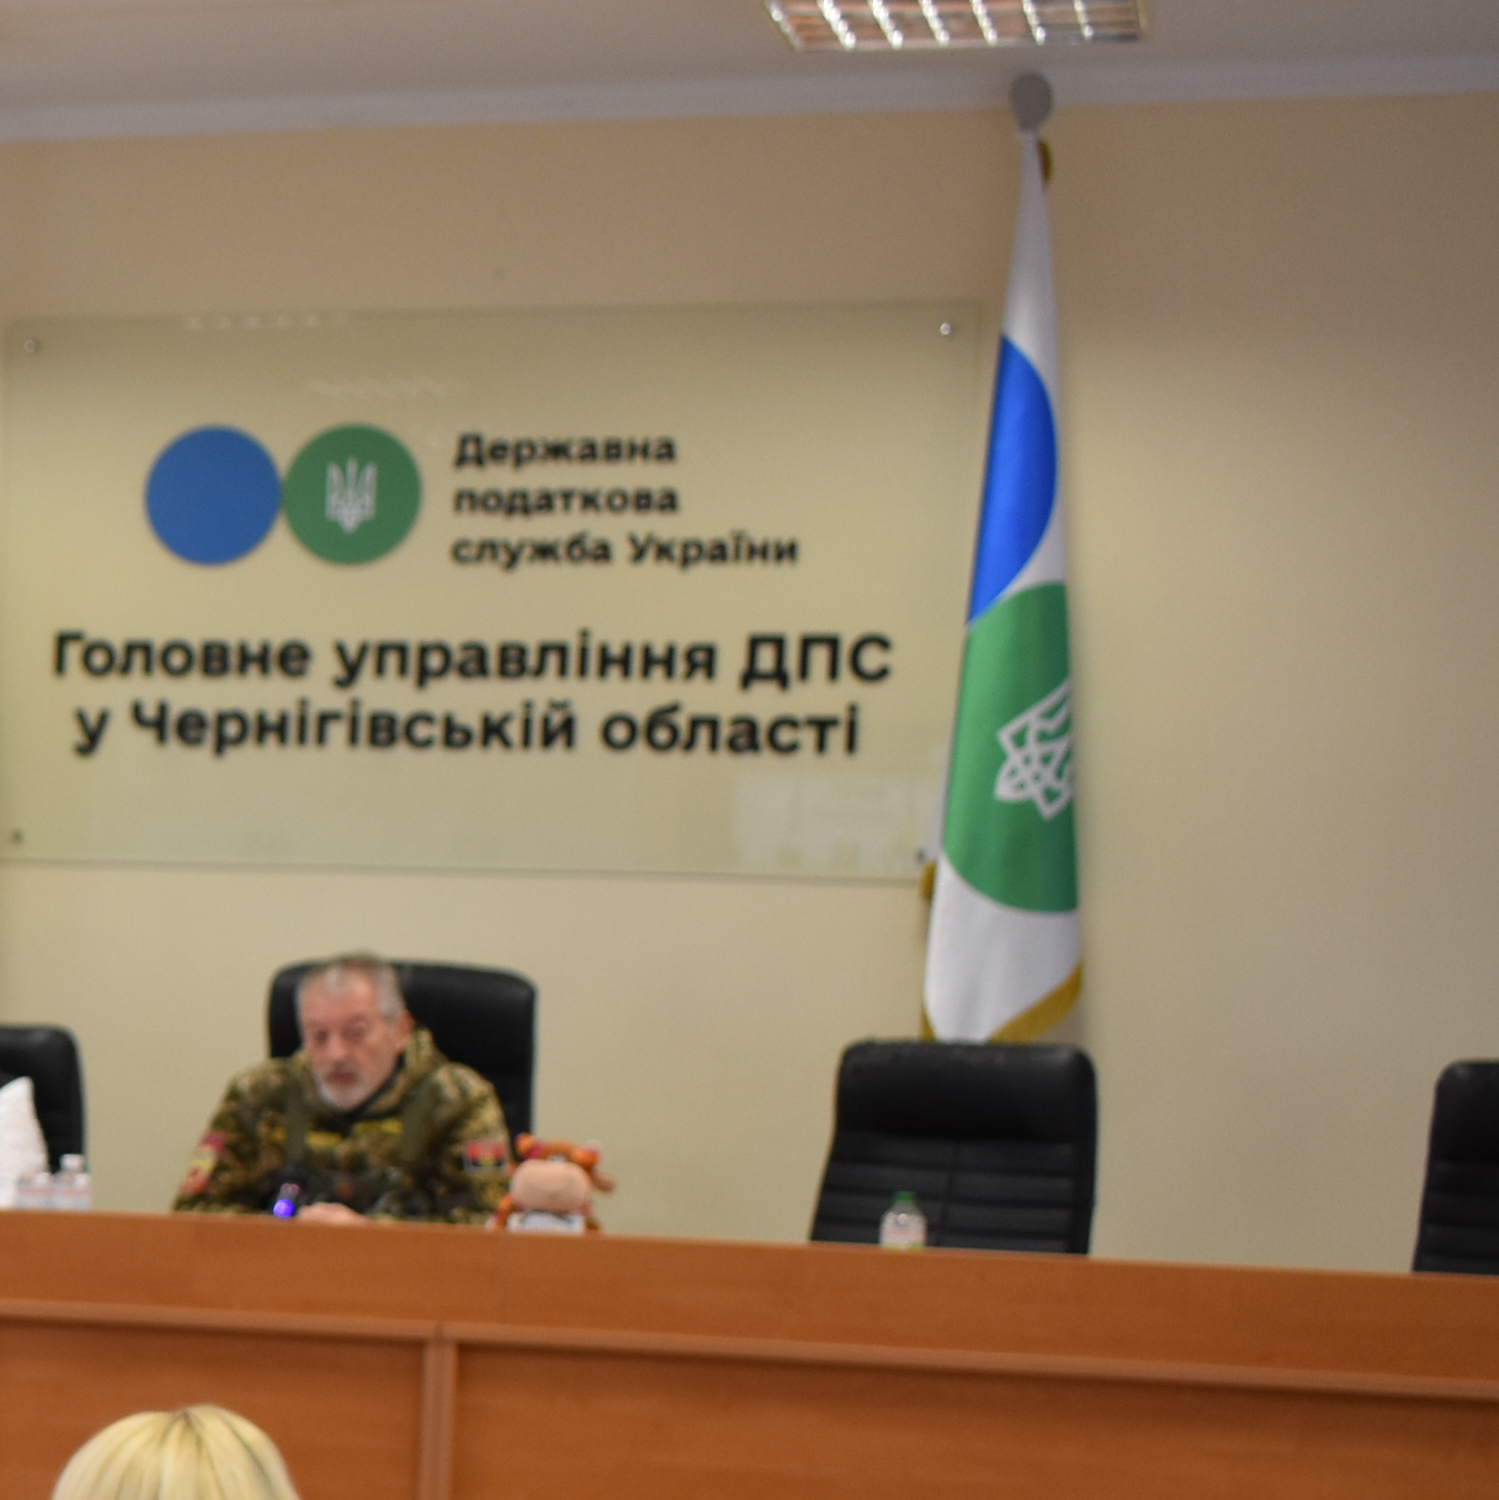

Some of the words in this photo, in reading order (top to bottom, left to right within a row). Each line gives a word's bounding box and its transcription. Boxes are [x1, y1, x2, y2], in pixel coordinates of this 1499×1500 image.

[453, 433, 677, 470] Державна
[452, 487, 680, 518] податкова
[450, 531, 614, 571] служба
[627, 529, 800, 571] України
[52, 629, 314, 679] Головне
[331, 628, 719, 690] управління
[738, 632, 894, 693] ДПС
[71, 706, 110, 759] у
[129, 696, 578, 759] Чернігівській
[598, 700, 861, 758] області
